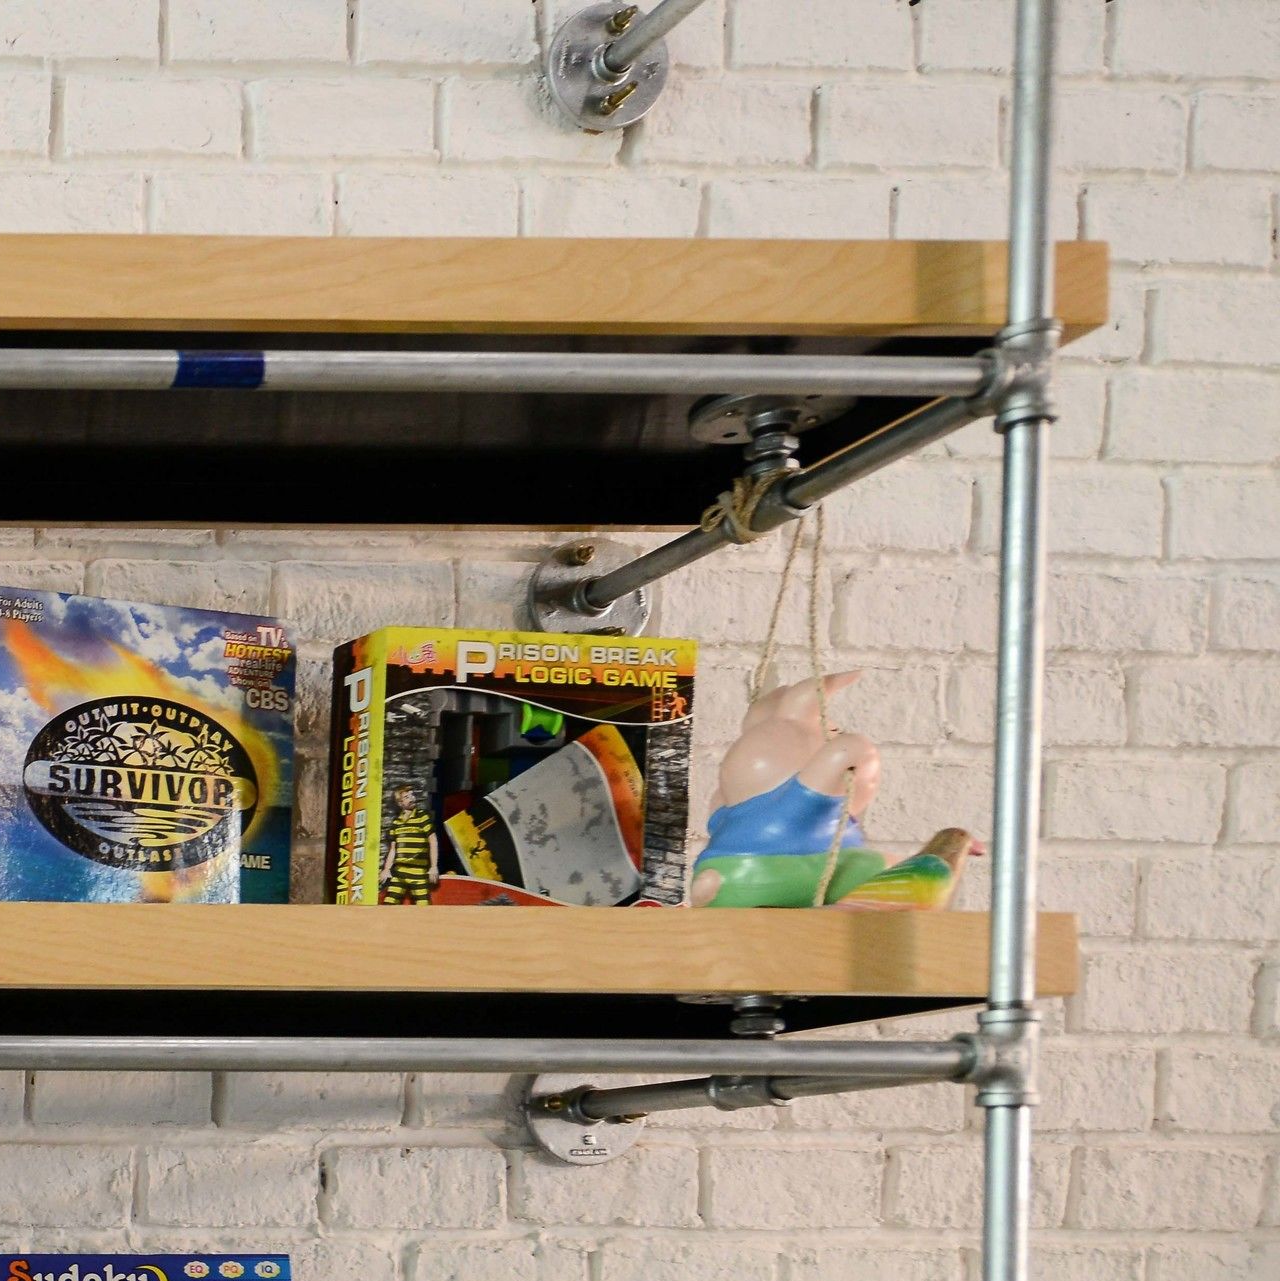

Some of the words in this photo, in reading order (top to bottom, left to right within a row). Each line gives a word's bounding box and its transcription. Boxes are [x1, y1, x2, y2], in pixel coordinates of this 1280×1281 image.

[12, 609, 45, 622] Players
[14, 597, 44, 610] Adults
[224, 642, 292, 663] HOTTEST
[455, 640, 580, 684] PRISON
[591, 646, 678, 668] BREAK
[515, 665, 592, 686] LOGIC
[603, 669, 679, 690] GAME
[245, 687, 290, 711] CBS
[65, 702, 140, 733] OUTWIT
[151, 703, 234, 752] OUTPLAY
[344, 667, 373, 800] PRISON
[48, 764, 237, 809] SURVIVOR
[341, 735, 356, 817] LOGIC
[239, 853, 272, 870] AME
[335, 827, 352, 905] GAME
[350, 807, 368, 903] BREAK
[189, 1265, 204, 1274] EQ
[261, 1265, 274, 1274] IQ
